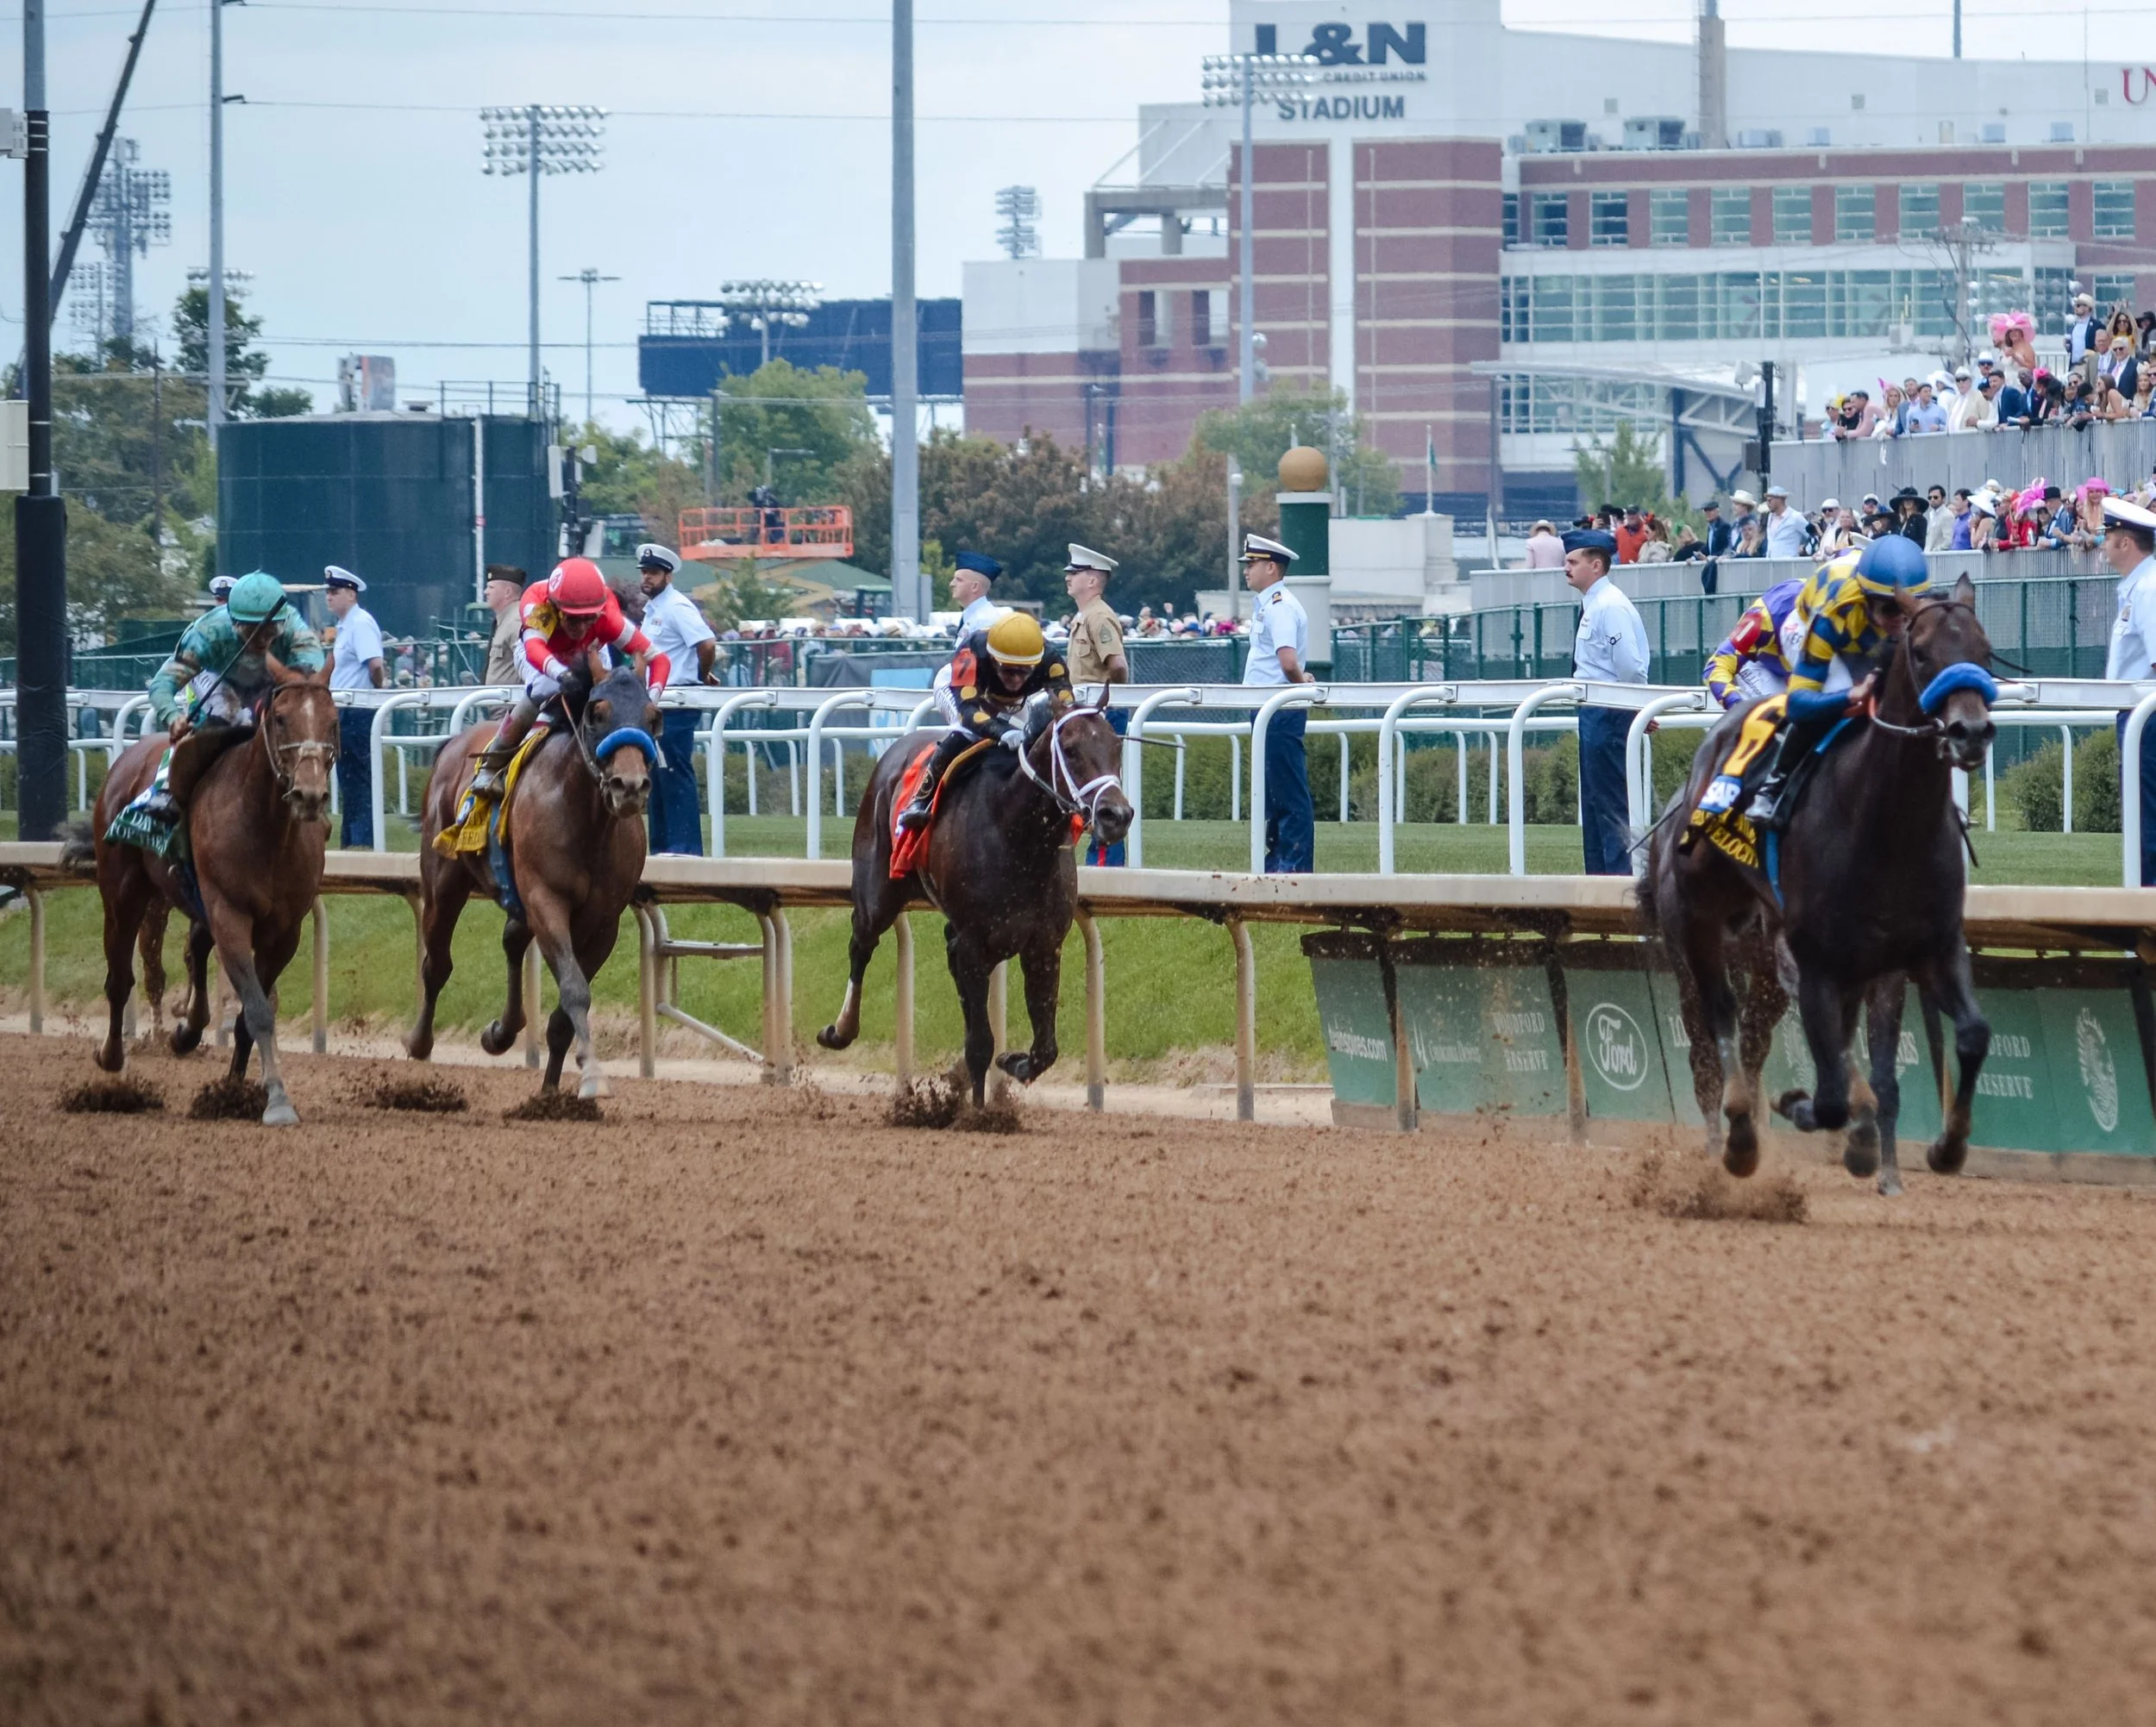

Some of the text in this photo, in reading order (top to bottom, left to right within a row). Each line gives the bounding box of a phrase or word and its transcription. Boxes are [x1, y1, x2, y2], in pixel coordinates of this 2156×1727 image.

[1255, 22, 1426, 66] L&N
[1278, 94, 1405, 120] STADIUM
[1598, 1014, 1637, 1075] Ford
